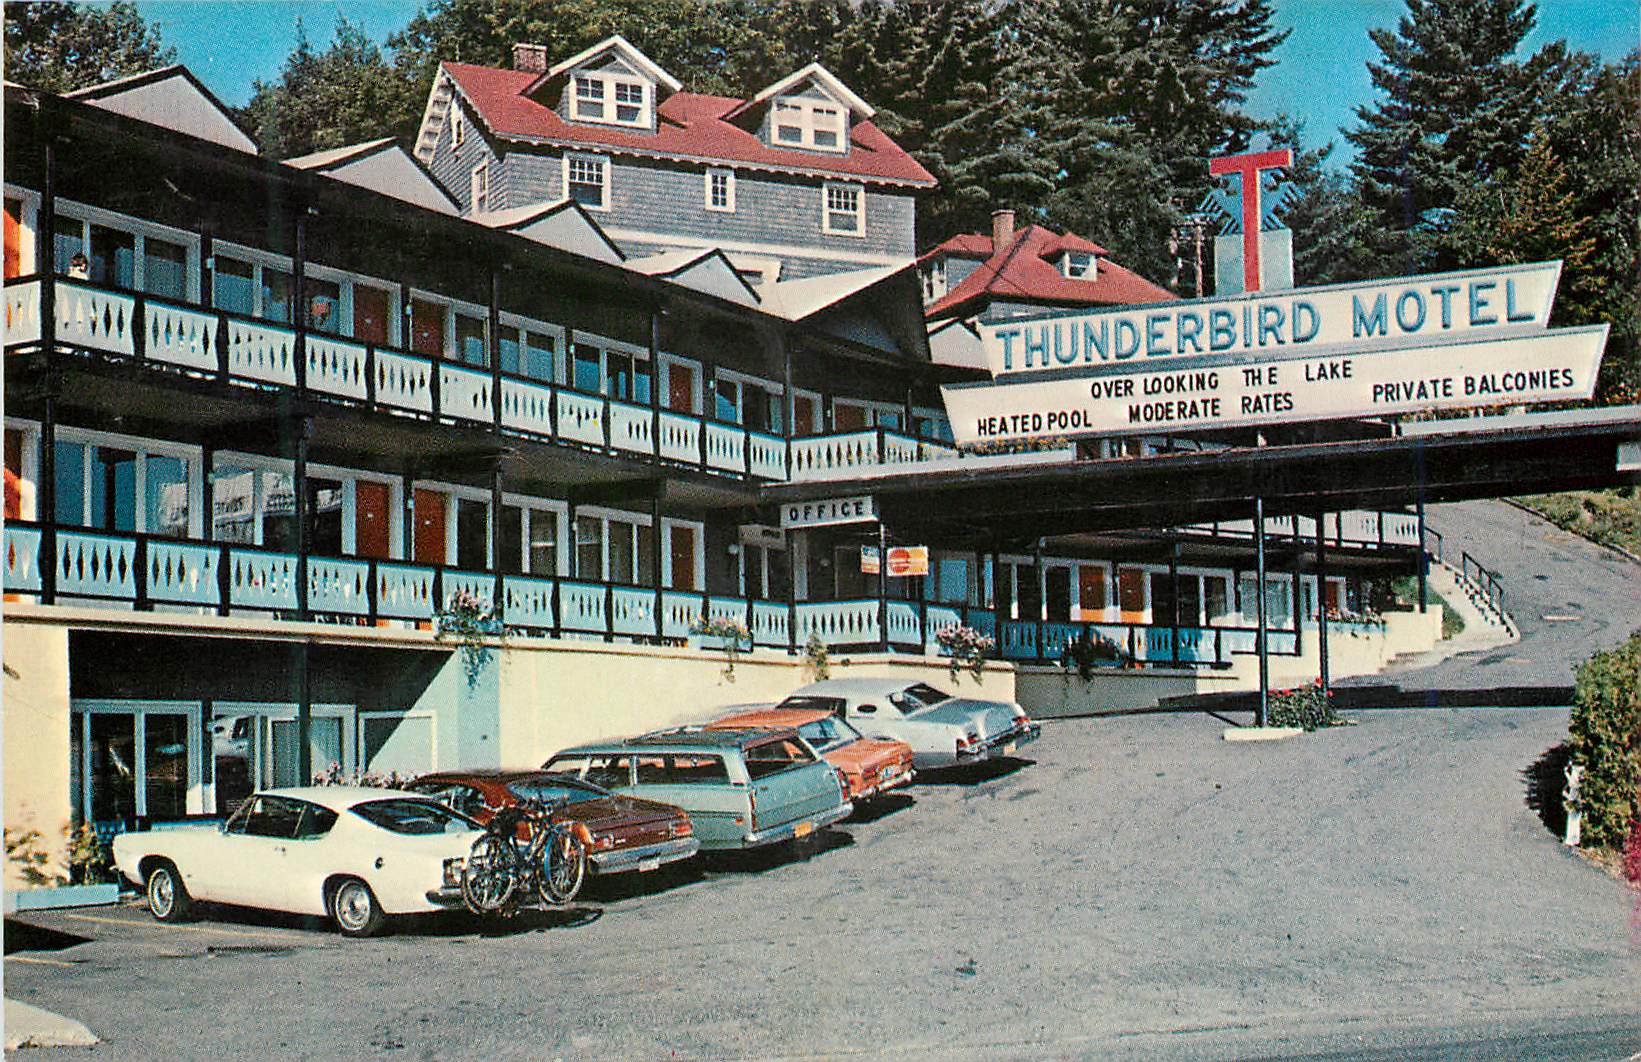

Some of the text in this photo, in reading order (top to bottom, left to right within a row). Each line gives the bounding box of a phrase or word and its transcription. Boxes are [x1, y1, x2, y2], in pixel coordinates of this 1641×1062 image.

[995, 278, 1536, 370] THUNDERBIRD MOTEL
[977, 368, 1574, 436] HEATED POOL MODERATE RATES PRIVATE BALCONIES
[1091, 360, 1353, 399] OVER LOOKING THE LAKE
[789, 501, 864, 521] OFFICE
